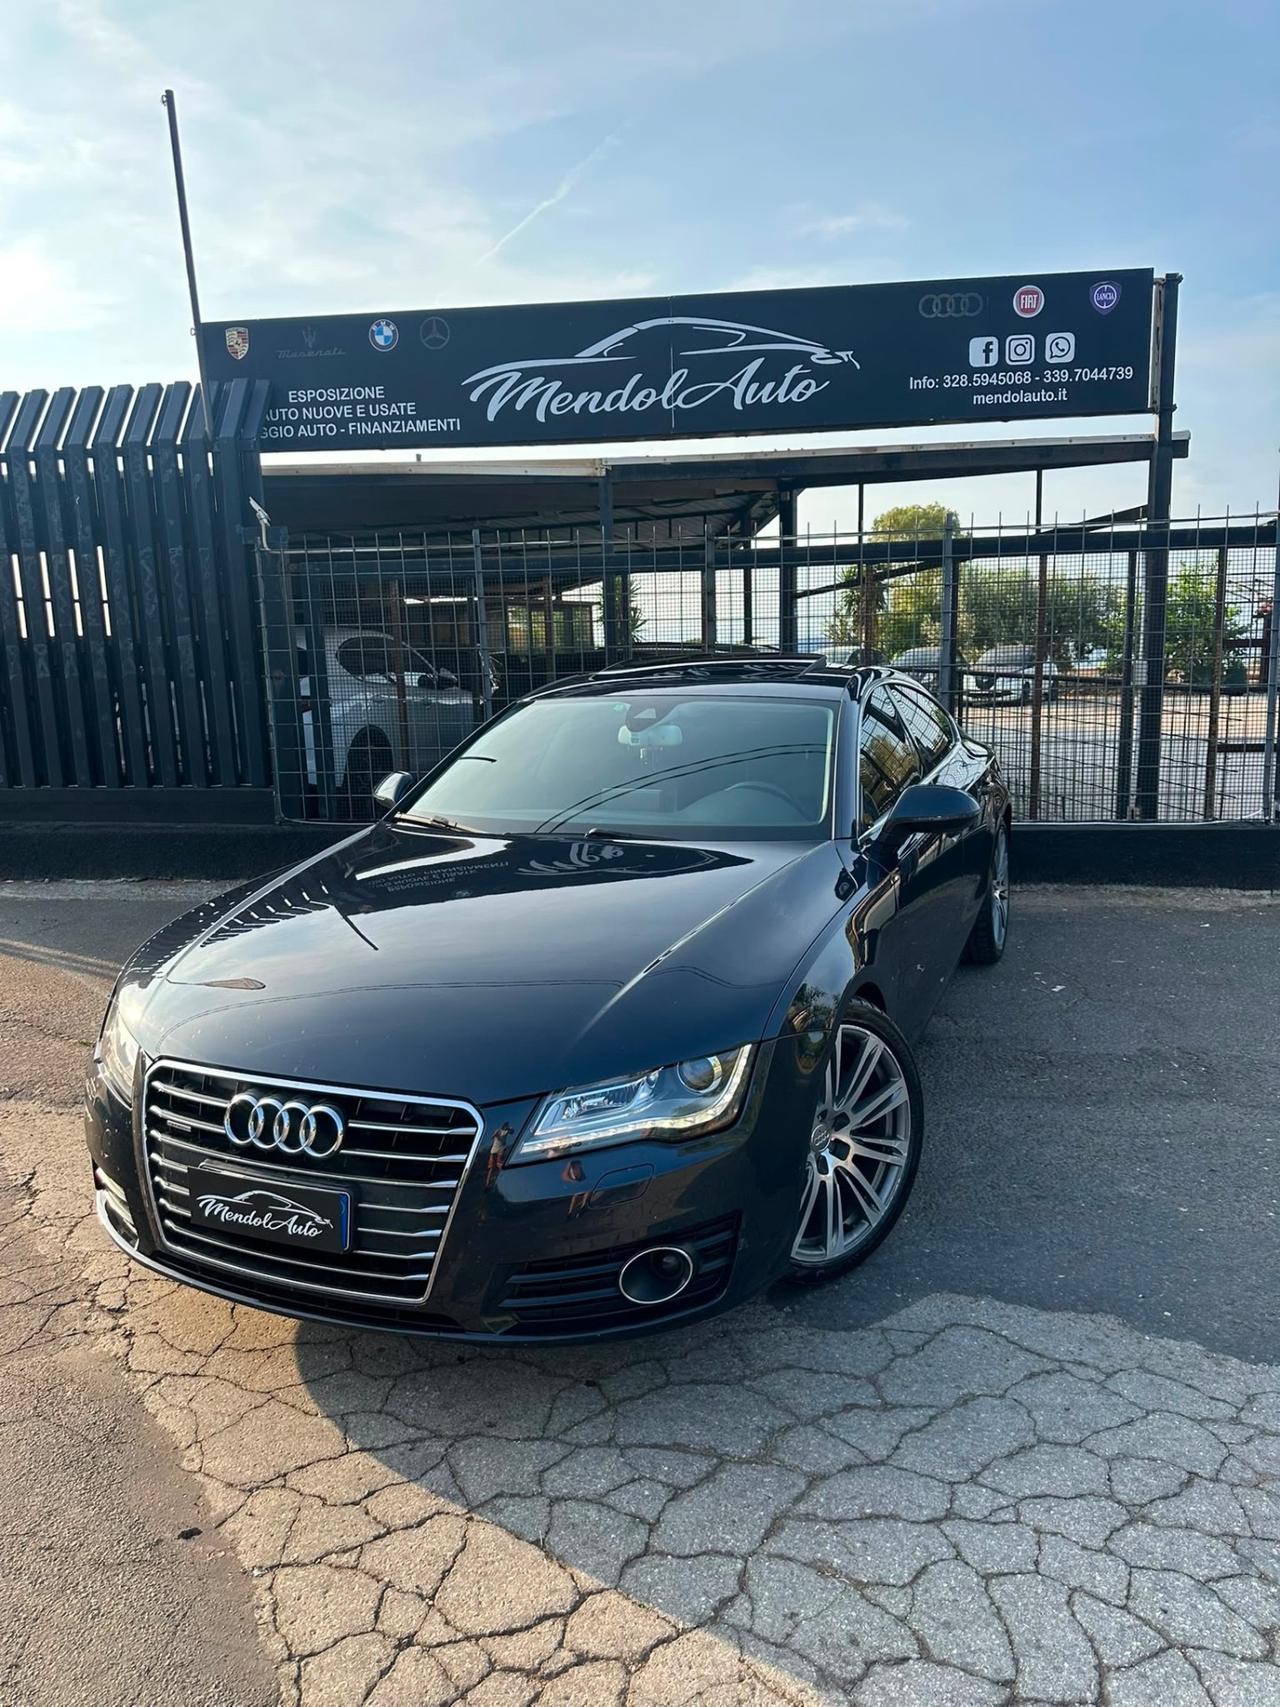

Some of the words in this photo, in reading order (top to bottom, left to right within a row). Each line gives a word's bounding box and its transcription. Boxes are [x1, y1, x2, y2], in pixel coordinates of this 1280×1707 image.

[1020, 294, 1039, 309] FIAT
[909, 375, 939, 390] Info:
[943, 371, 1032, 388] 328.5945068
[1043, 366, 1134, 383] 339.7044739
[288, 386, 385, 403] ESPOSIZIONE
[973, 388, 1068, 405] mendolauto.it
[303, 405, 353, 420] NUOVE
[356, 404, 366, 417] E
[369, 402, 416, 416] USATE
[298, 423, 337, 437] AUTO
[349, 418, 461, 435] FINANZIAMENTI
